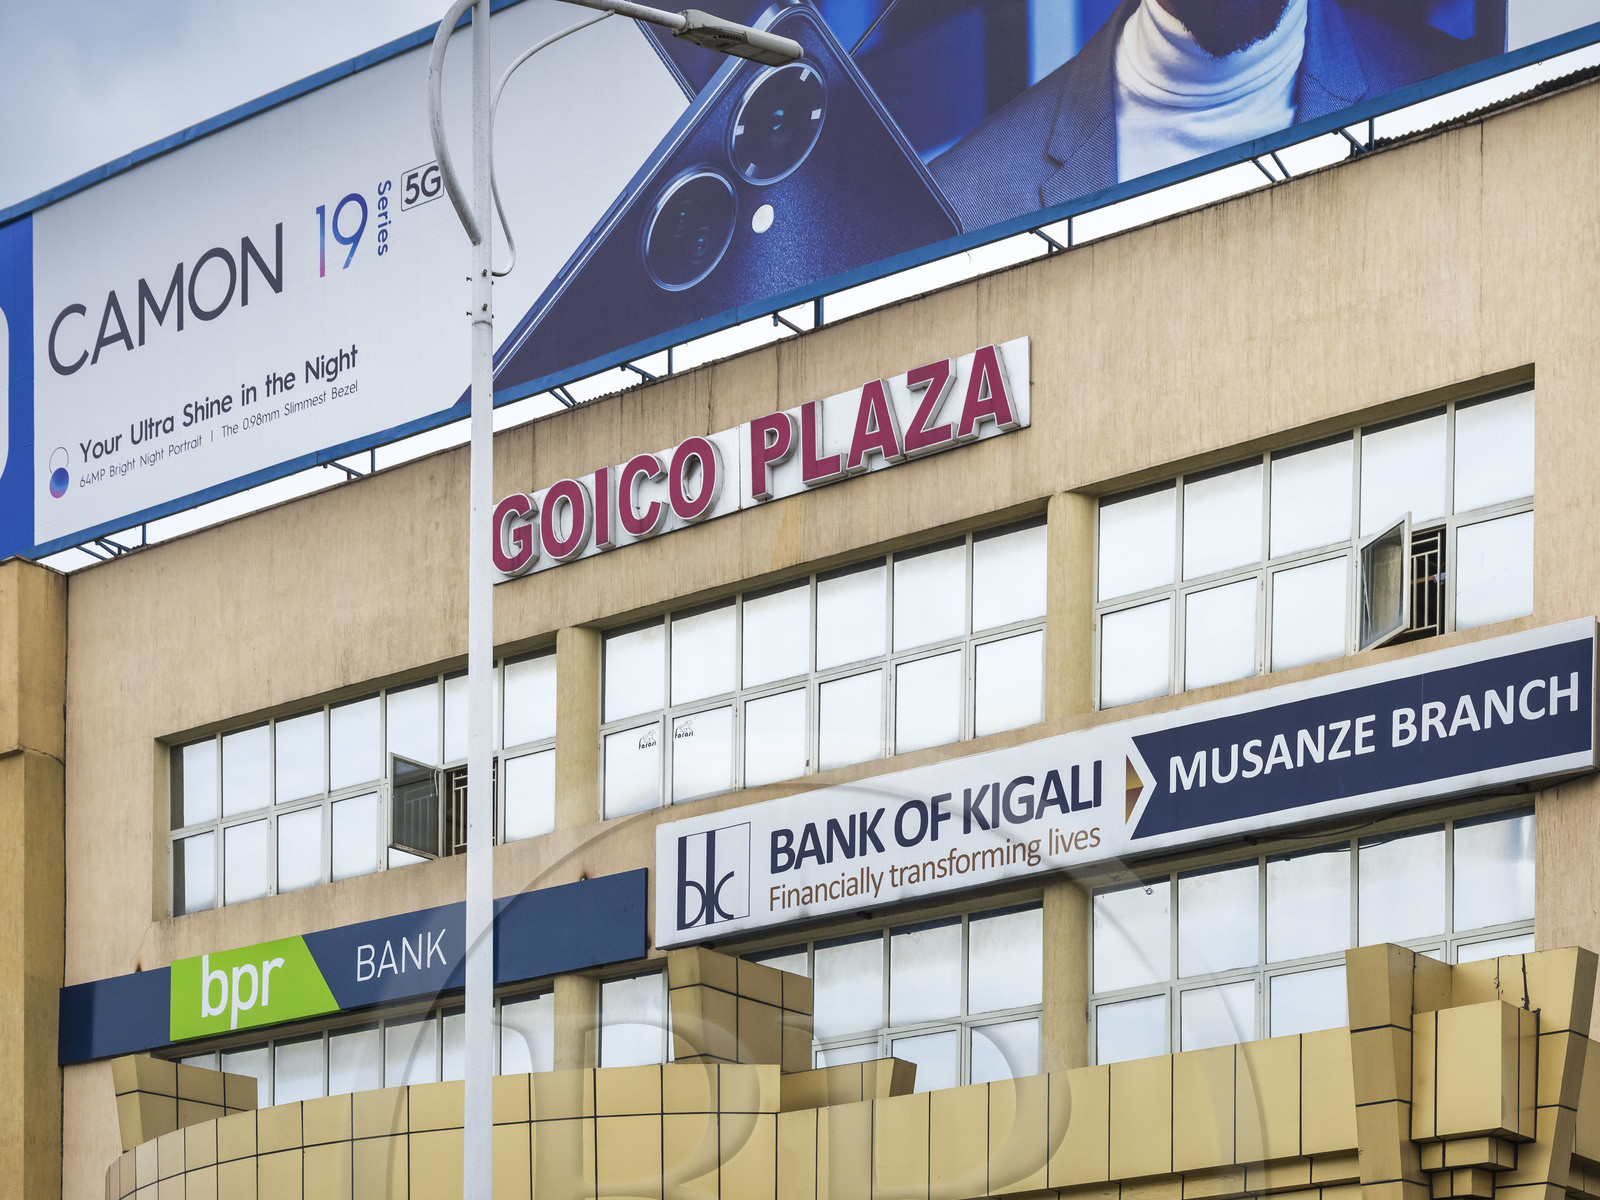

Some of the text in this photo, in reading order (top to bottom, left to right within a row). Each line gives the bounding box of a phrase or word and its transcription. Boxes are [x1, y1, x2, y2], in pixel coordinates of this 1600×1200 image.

[377, 180, 392, 256] Series
[404, 165, 442, 205] 5G
[48, 193, 368, 377] CAMON 19
[79, 344, 358, 463] Your Ultra Shine in the Night
[79, 380, 358, 488] 64MP Bright Night Portrait The 0.98mm Slimmest Bezel
[493, 345, 1020, 577] GOICO PLAZA
[1168, 671, 1580, 796] MUSANZE BRANCH
[769, 759, 1103, 874] BANK OF KIGALI
[769, 824, 1101, 912] Financially transforming lives
[200, 929, 448, 1030] bpr BANK
